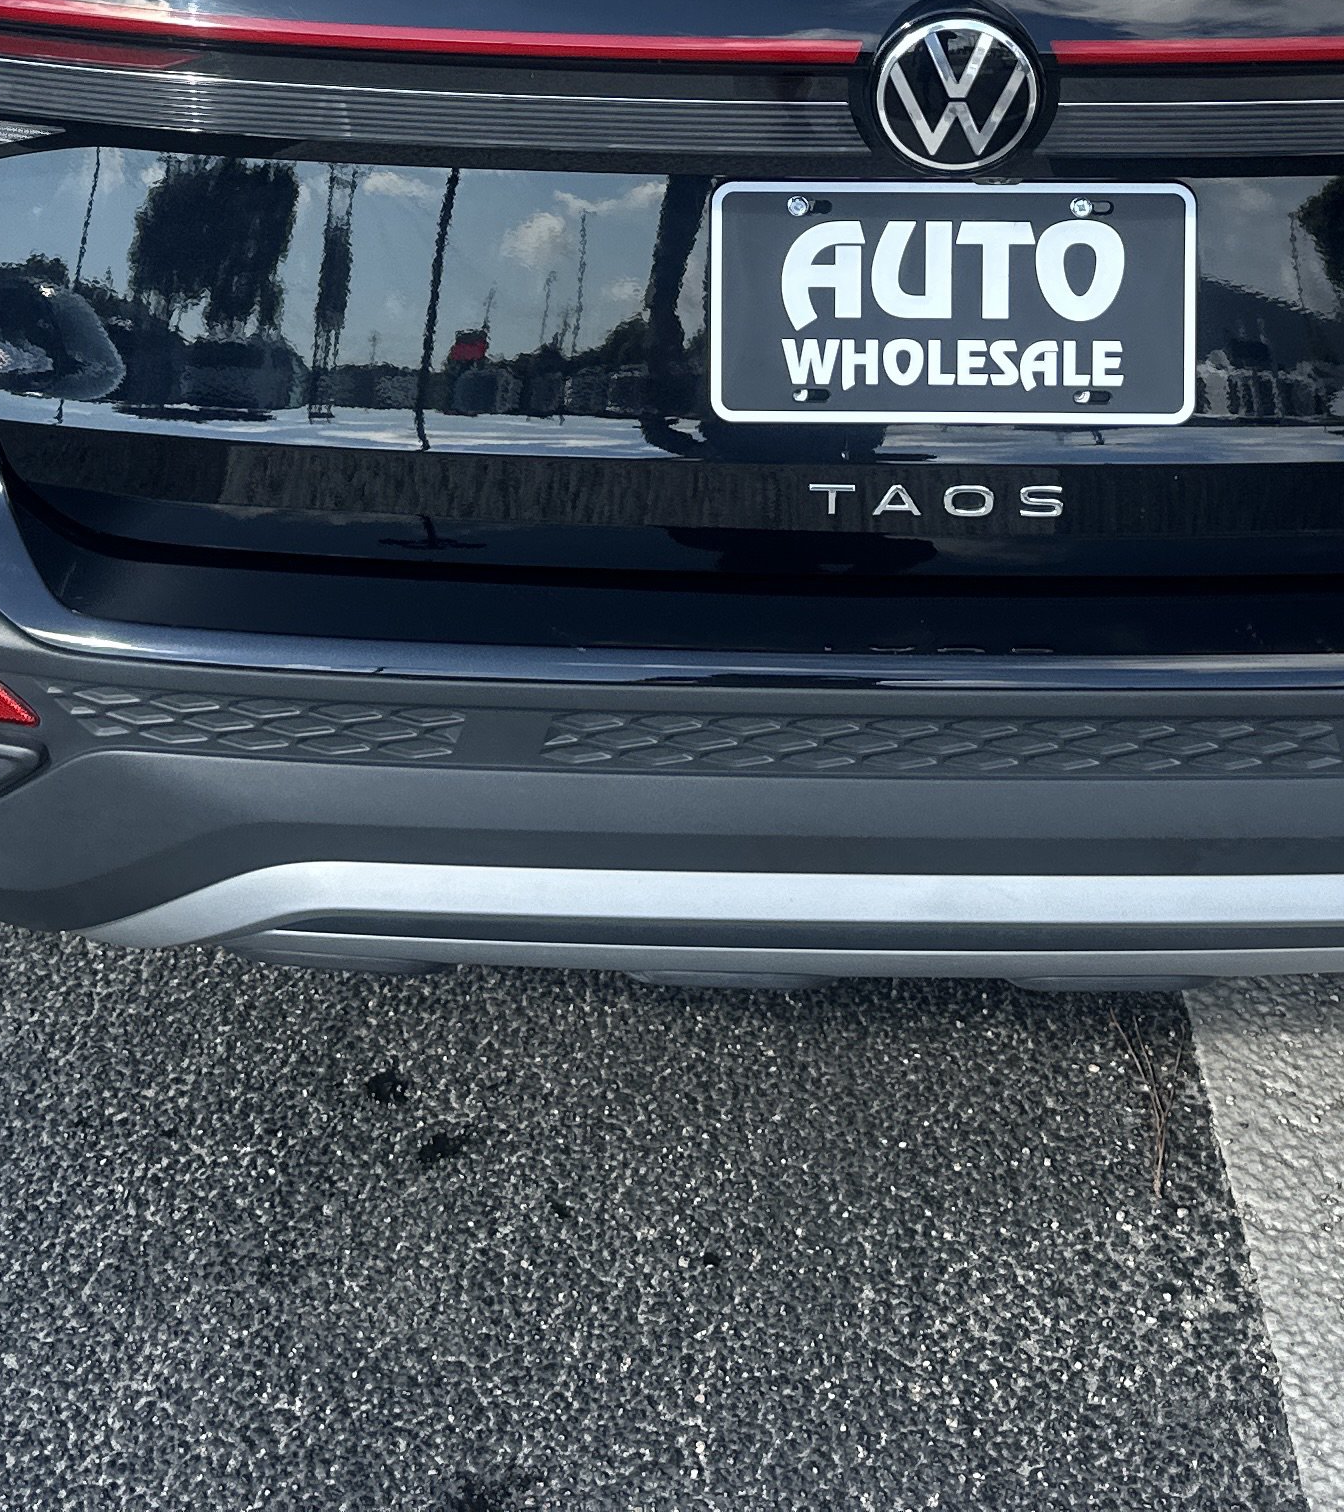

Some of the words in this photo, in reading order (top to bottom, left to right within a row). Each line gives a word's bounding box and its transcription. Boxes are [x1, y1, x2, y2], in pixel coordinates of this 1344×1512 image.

[781, 219, 1125, 331] AUTO
[781, 338, 1125, 392] WHOLESALE
[809, 483, 1064, 517] TAOS
